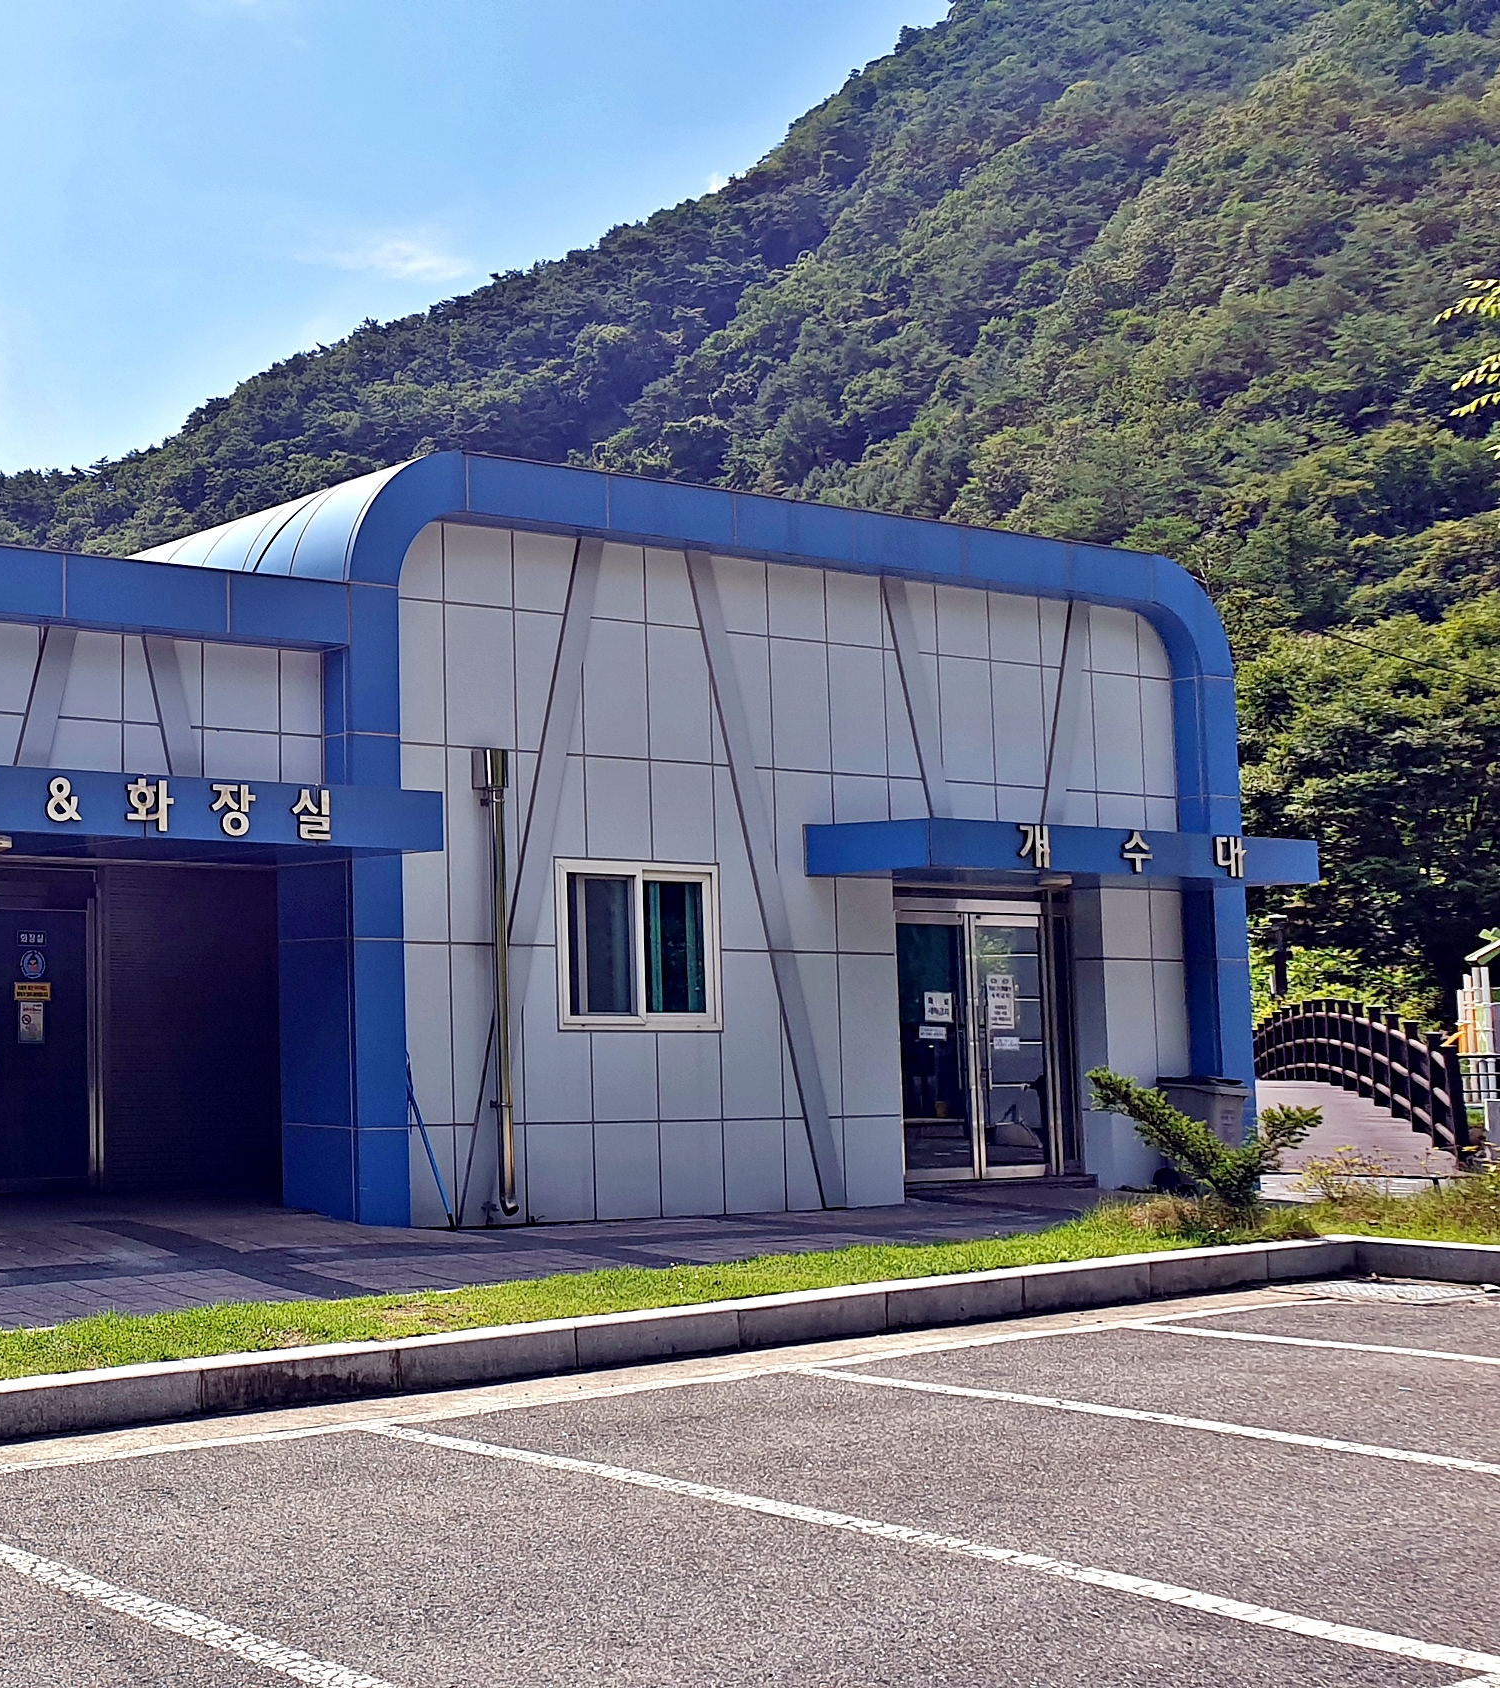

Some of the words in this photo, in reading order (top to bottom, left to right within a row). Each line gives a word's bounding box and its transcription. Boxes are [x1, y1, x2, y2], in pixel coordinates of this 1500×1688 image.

[46, 776, 82, 822] &
[126, 778, 332, 840] 화장실
[1017, 824, 1247, 878] 개수대
[20, 933, 44, 943] 화장실
